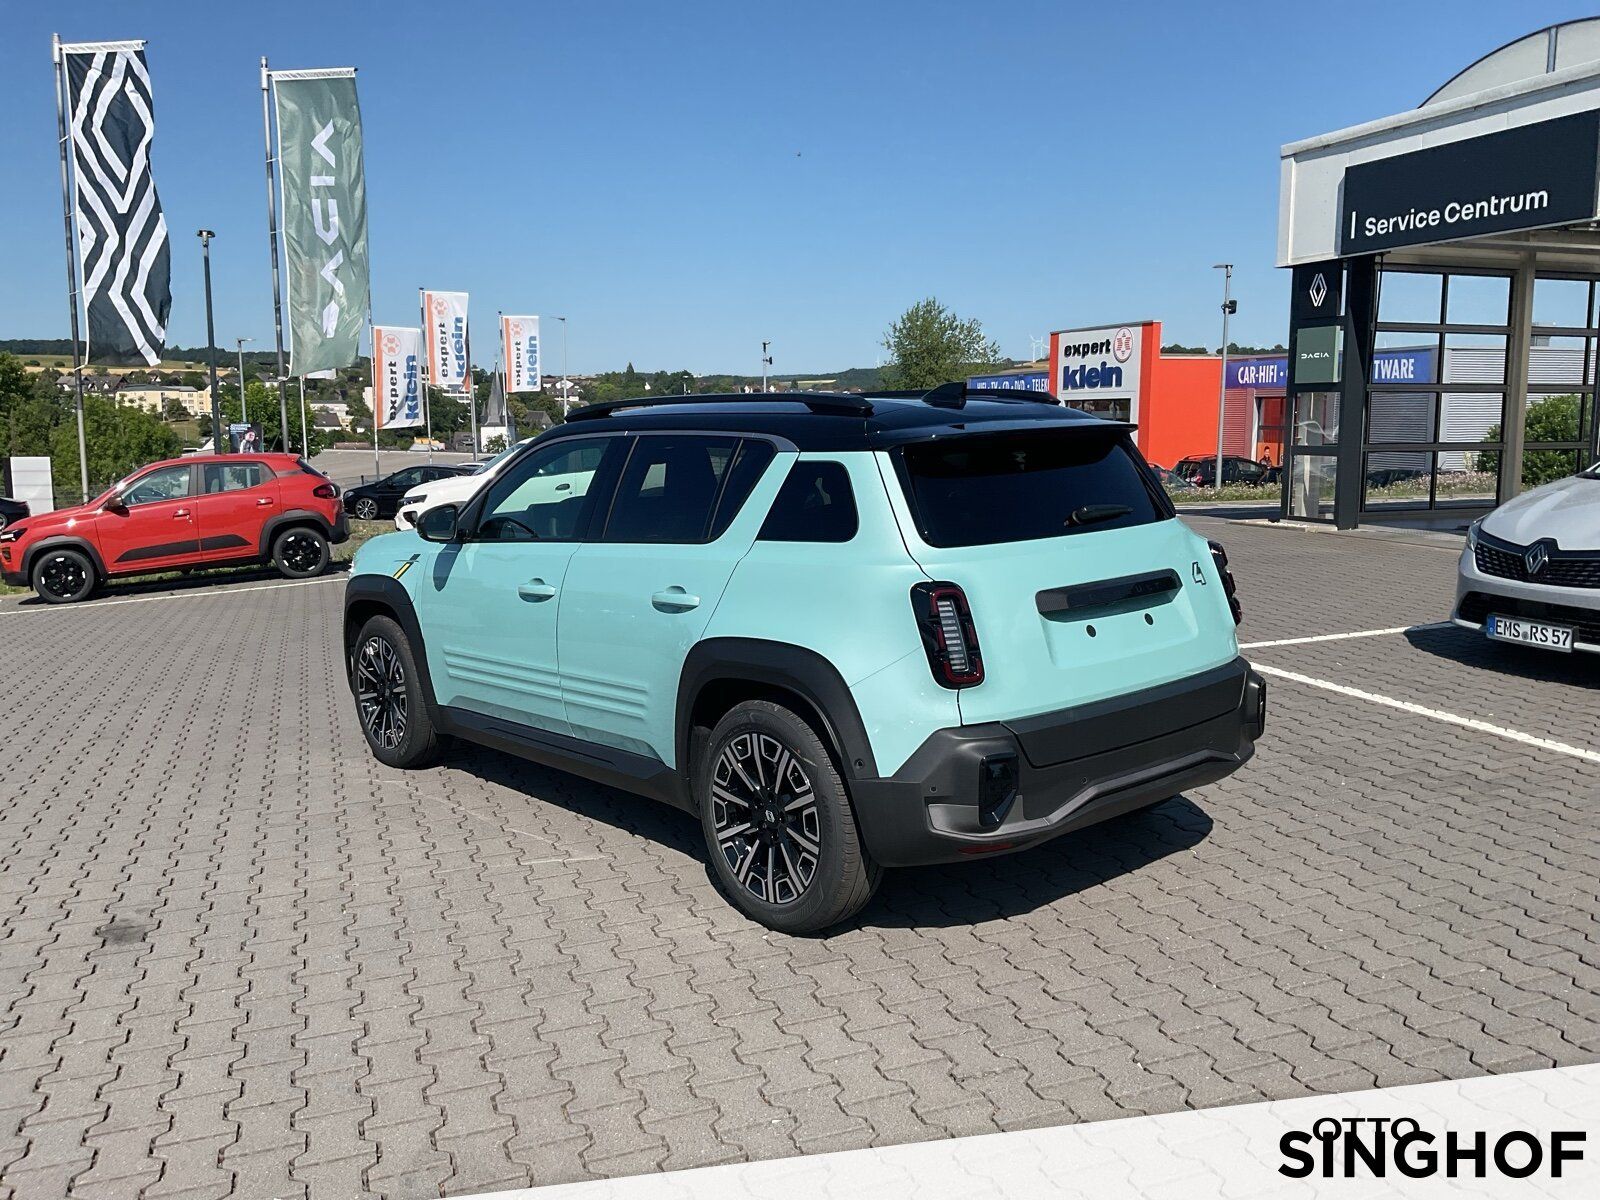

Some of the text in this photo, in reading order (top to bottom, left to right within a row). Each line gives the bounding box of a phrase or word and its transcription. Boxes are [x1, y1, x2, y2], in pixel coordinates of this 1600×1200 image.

[1365, 189, 1548, 237] Service Centrum
[438, 322, 450, 378] expert
[452, 316, 466, 378] klein
[514, 340, 523, 386] expert
[526, 335, 538, 387] klein
[1064, 338, 1111, 359] expert
[388, 360, 399, 421] expert
[403, 355, 419, 420] klein
[1031, 378, 1050, 392] TELEK
[1062, 361, 1123, 391] klein
[1495, 619, 1521, 638] EMS
